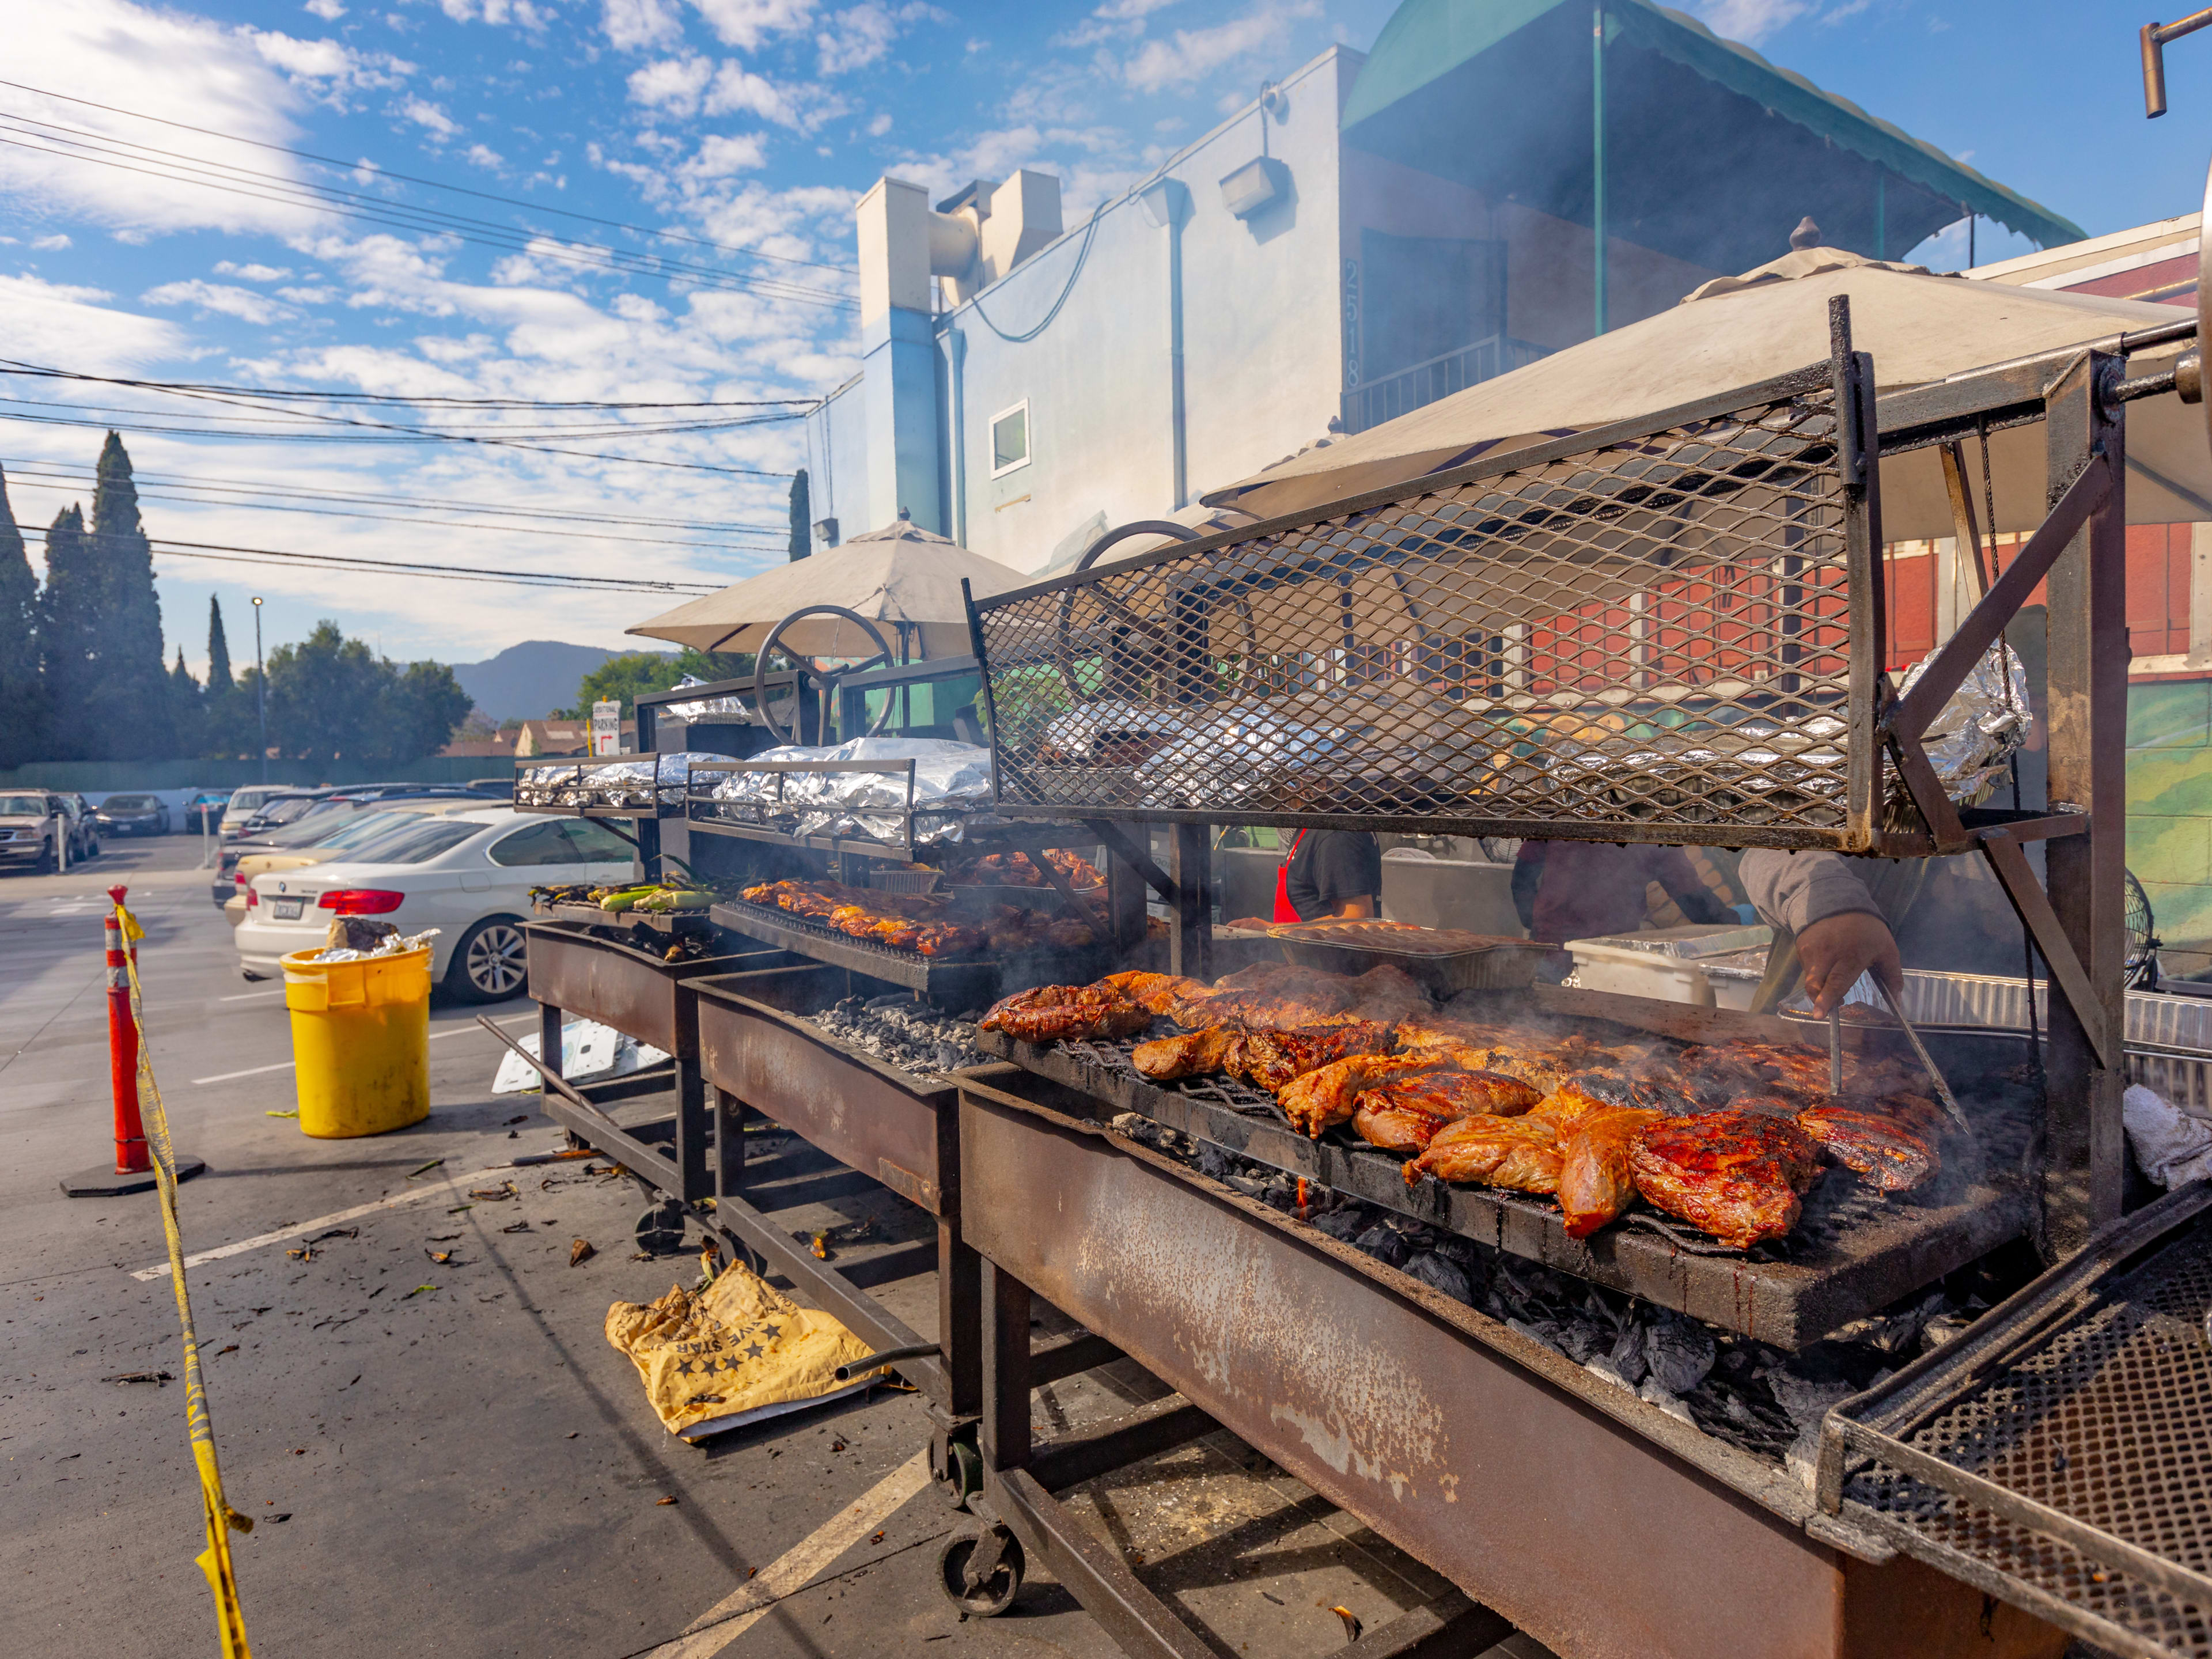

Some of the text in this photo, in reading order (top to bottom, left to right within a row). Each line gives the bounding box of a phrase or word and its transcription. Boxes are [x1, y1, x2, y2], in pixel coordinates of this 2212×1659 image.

[1347, 262, 1359, 387] 2518
[594, 718, 617, 731] PARKING
[727, 1322, 762, 1347] FIVE
[676, 1340, 722, 1353] STAR
